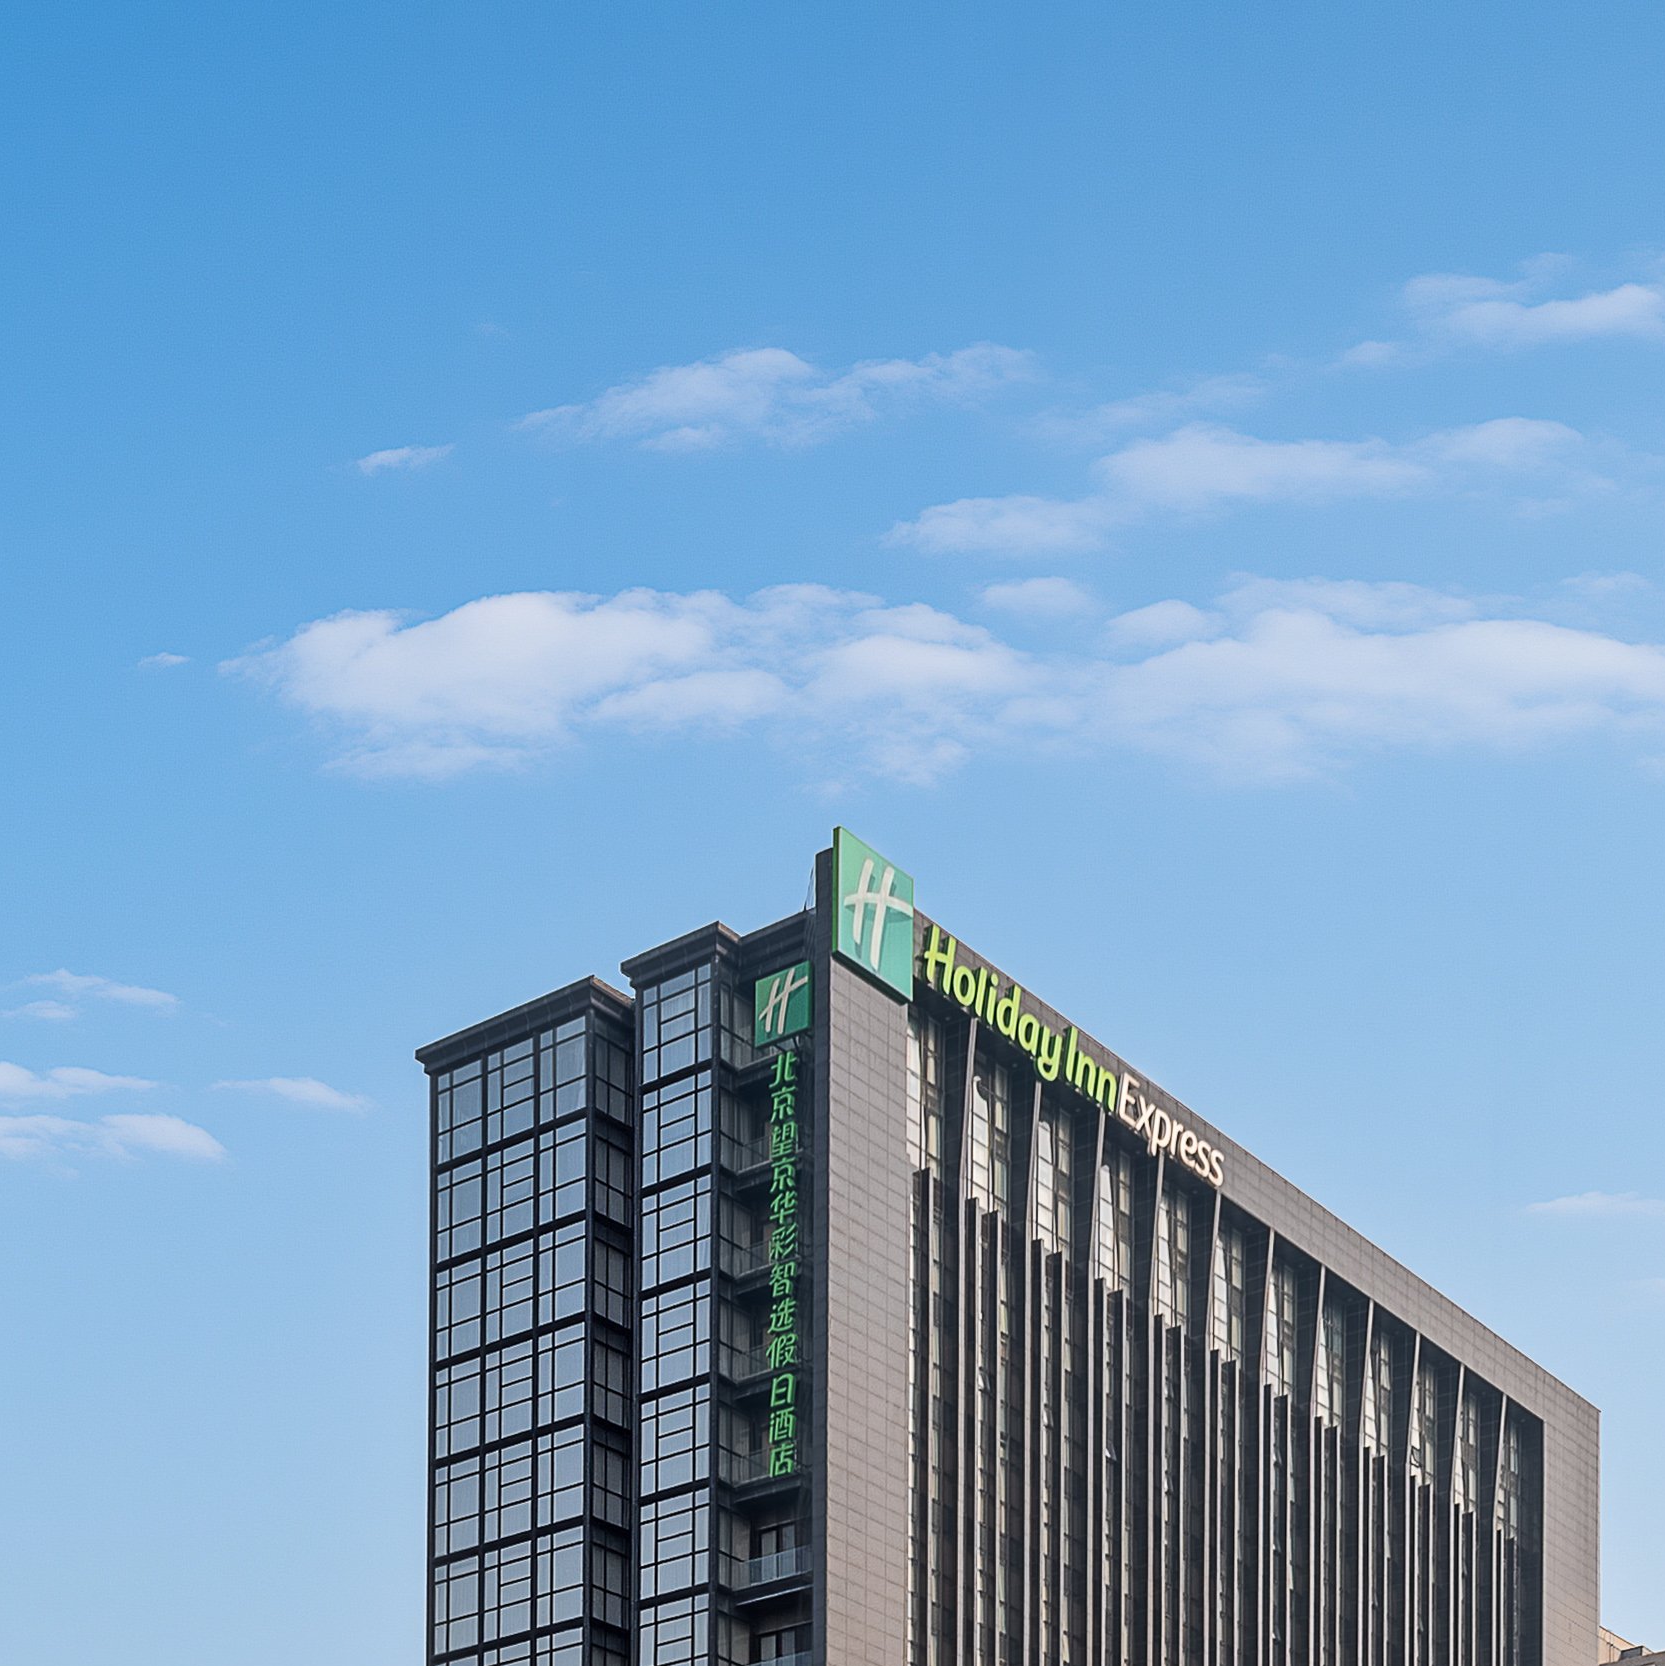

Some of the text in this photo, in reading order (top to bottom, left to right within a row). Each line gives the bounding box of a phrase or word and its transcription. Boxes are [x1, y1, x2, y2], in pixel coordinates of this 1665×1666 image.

[924, 925, 1225, 1186] Holiday Inn Express
[767, 1052, 797, 1477] 北京望京华彩智选假日酒店
